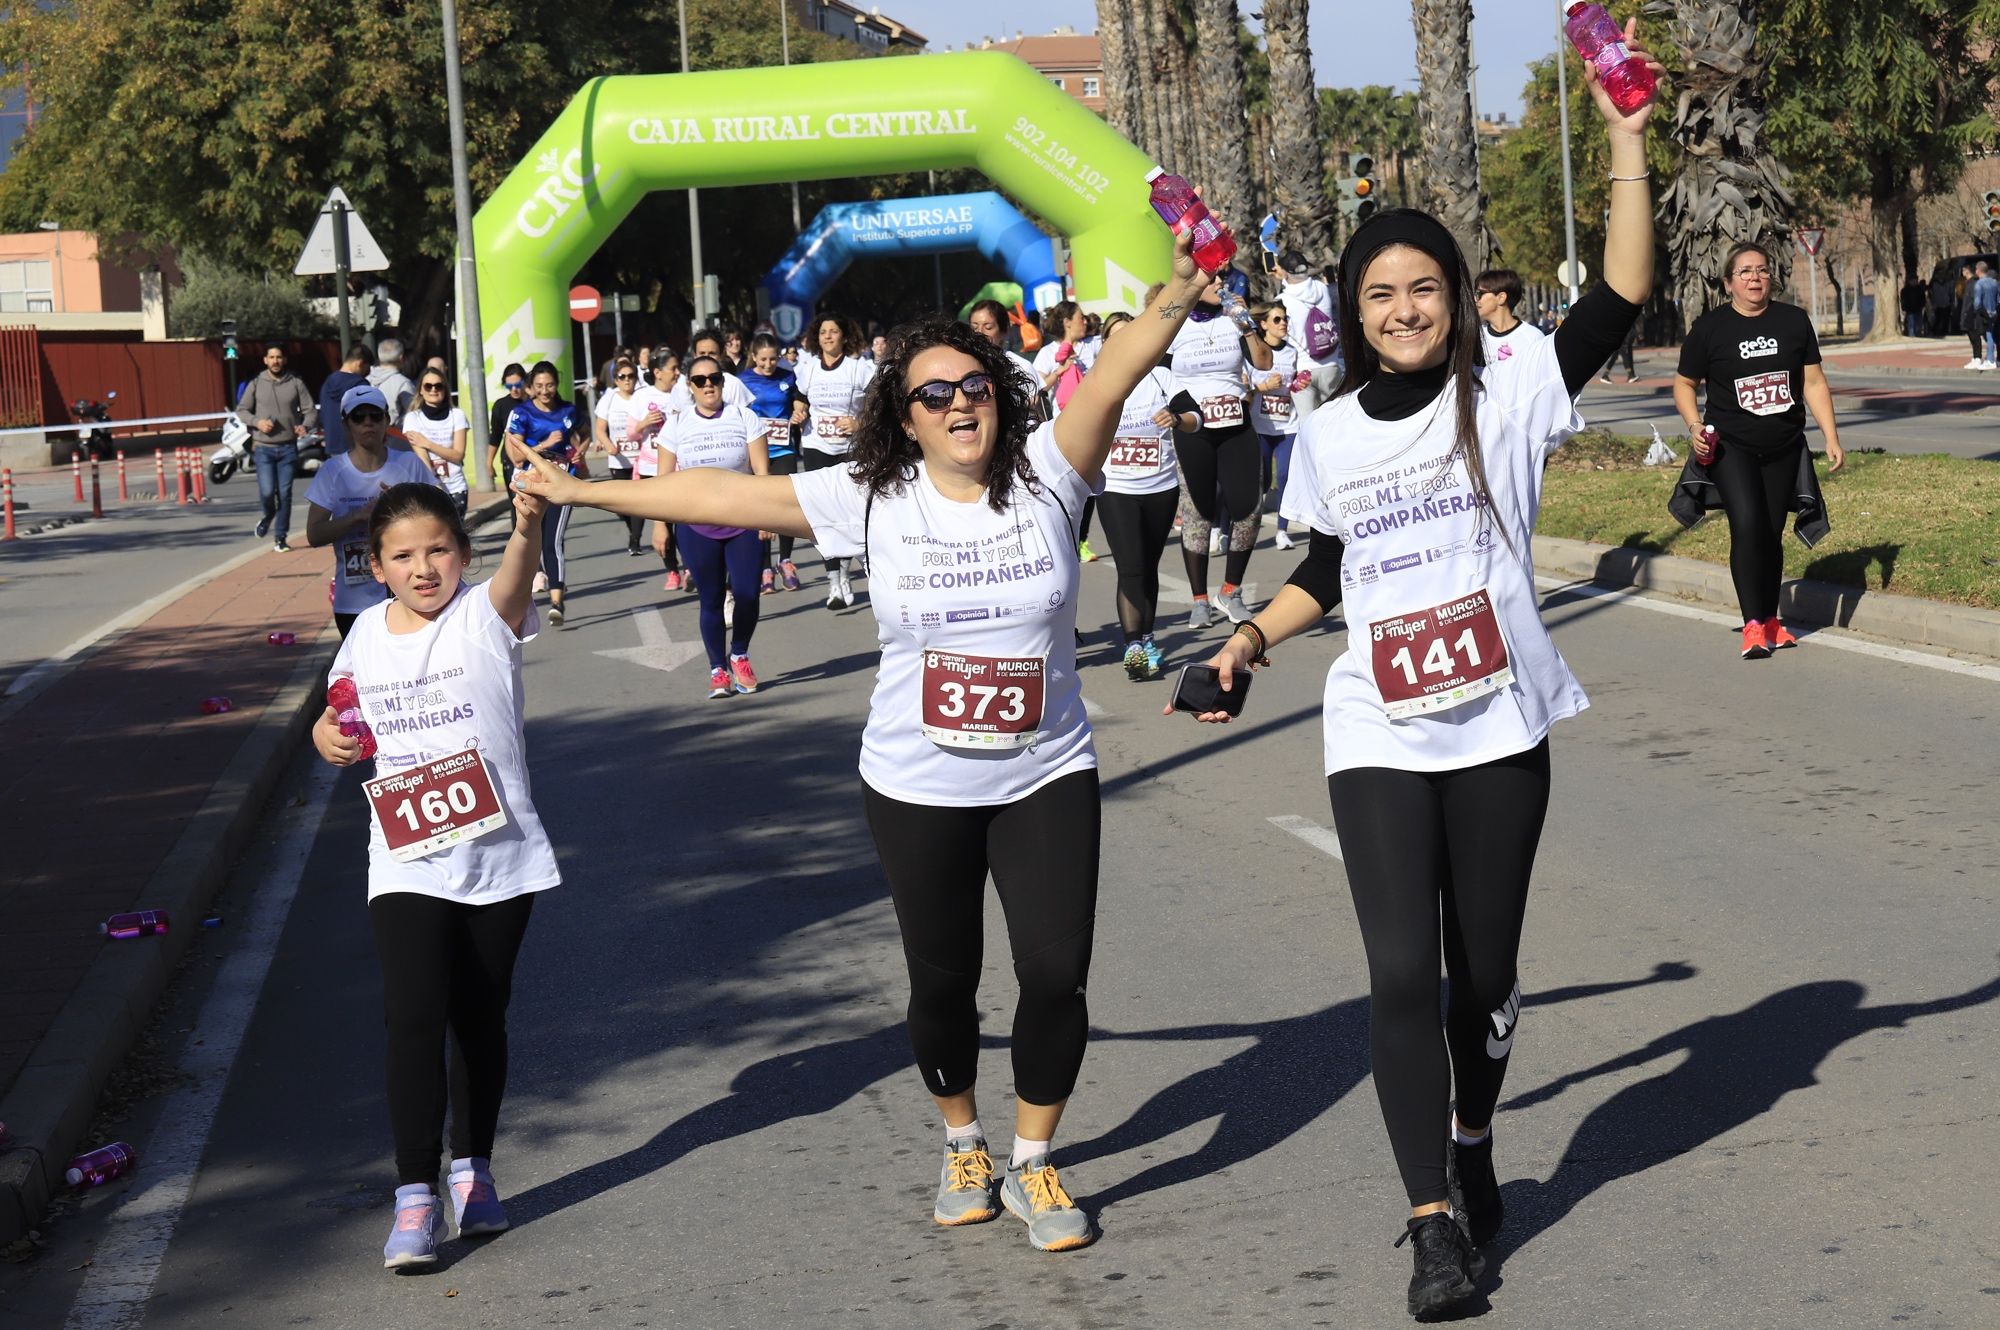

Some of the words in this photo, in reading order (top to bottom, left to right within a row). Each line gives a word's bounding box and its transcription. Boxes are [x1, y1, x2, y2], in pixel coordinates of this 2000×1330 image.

[628, 118, 705, 144] CAJA
[712, 115, 820, 143] RURAL
[825, 109, 976, 139] CENTRAL
[1013, 116, 1046, 146] 902
[1044, 141, 1077, 170] 104
[1077, 164, 1109, 194] 102
[1004, 133, 1097, 205] www.ruralcentral.es
[517, 148, 600, 238] CRC
[852, 206, 972, 231] UNIVERSAE
[852, 231, 895, 243] Instituto
[897, 226, 942, 240] Superior
[943, 225, 956, 235] de
[959, 223, 973, 234] FP
[1741, 384, 1788, 406] 2576
[1204, 403, 1240, 419] 1023
[694, 441, 743, 452] COMPAÑERAS
[1112, 447, 1158, 463] 4732
[1337, 475, 1384, 494] CARRERA
[1387, 470, 1401, 482] DE
[1403, 466, 1417, 477] LA
[1419, 454, 1452, 472] MUJER
[1339, 495, 1375, 519] POR
[1375, 480, 1403, 507] MÍ
[1404, 482, 1418, 498] Y
[1421, 473, 1460, 496] POR
[1353, 490, 1489, 539] COMPAÑERAS
[901, 535, 920, 545] VIII
[981, 538, 994, 547] LA
[922, 552, 954, 567] POR
[956, 548, 981, 565] MÍ
[983, 549, 995, 562] Y
[897, 575, 925, 590] MIS
[929, 555, 1054, 589] COMPAÑERAS
[1389, 619, 1427, 641] mujer
[1436, 596, 1486, 620] MURCIA
[1454, 611, 1474, 622] MARZO
[1475, 605, 1488, 615] 2023
[1391, 628, 1482, 685] 141
[391, 682, 400, 691] DE
[402, 681, 413, 689] LA
[416, 674, 440, 688] MUJER
[442, 667, 464, 680] 2023
[947, 661, 987, 680] mujer
[997, 661, 1040, 672] MURCIA
[1423, 676, 1467, 694] VICTORIA
[384, 691, 402, 712] MÍ
[404, 696, 415, 710] Y
[417, 690, 447, 709] POR
[938, 682, 1026, 721] 373
[375, 703, 474, 736] COMPAÑERAS
[962, 723, 999, 731] MARIBEL
[390, 773, 424, 793] mujer
[431, 753, 475, 775] MURCIA
[446, 766, 465, 776] MARZO
[396, 781, 476, 831] 160
[431, 822, 456, 835] MARÍA
